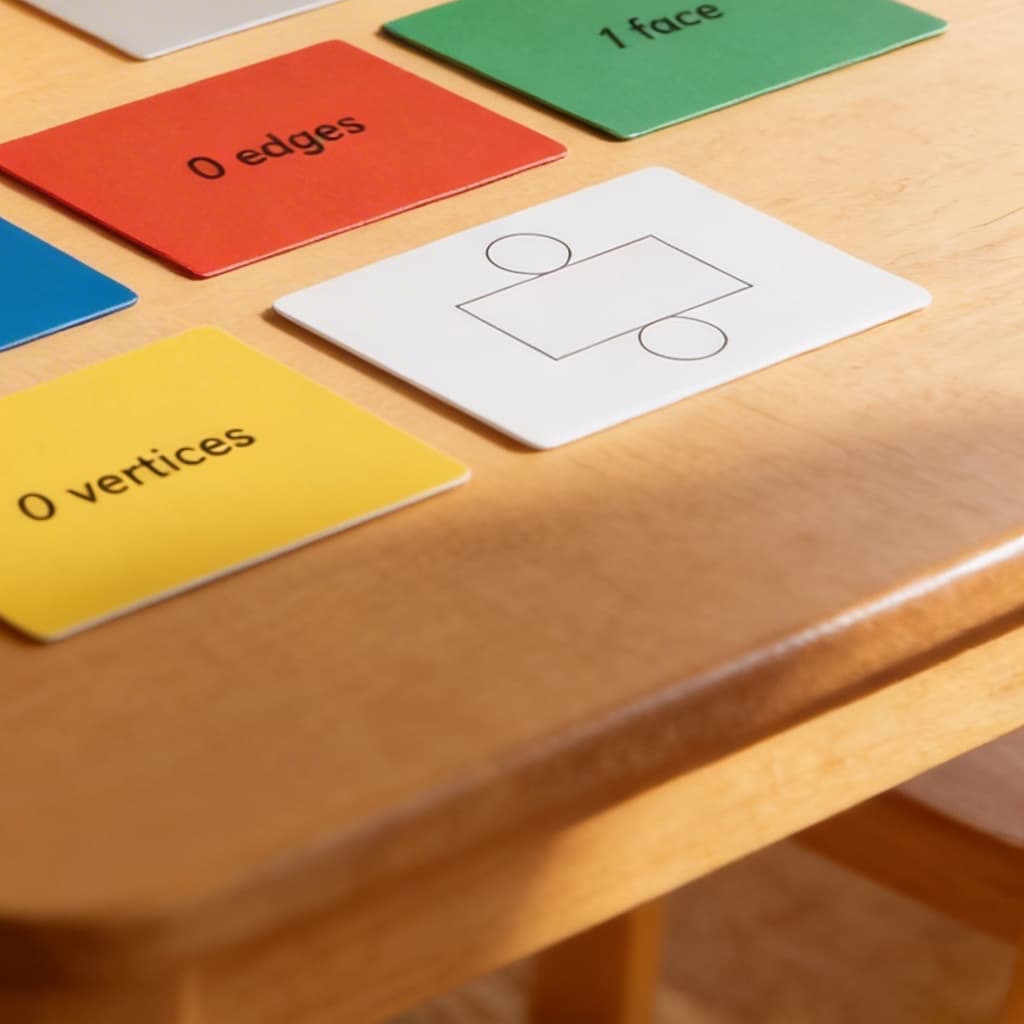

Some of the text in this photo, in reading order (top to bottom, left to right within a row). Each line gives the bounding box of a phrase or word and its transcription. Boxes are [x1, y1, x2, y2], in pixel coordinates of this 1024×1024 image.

[598, 4, 723, 50] 1 face
[235, 117, 366, 167] edges
[67, 426, 256, 504] vertices
